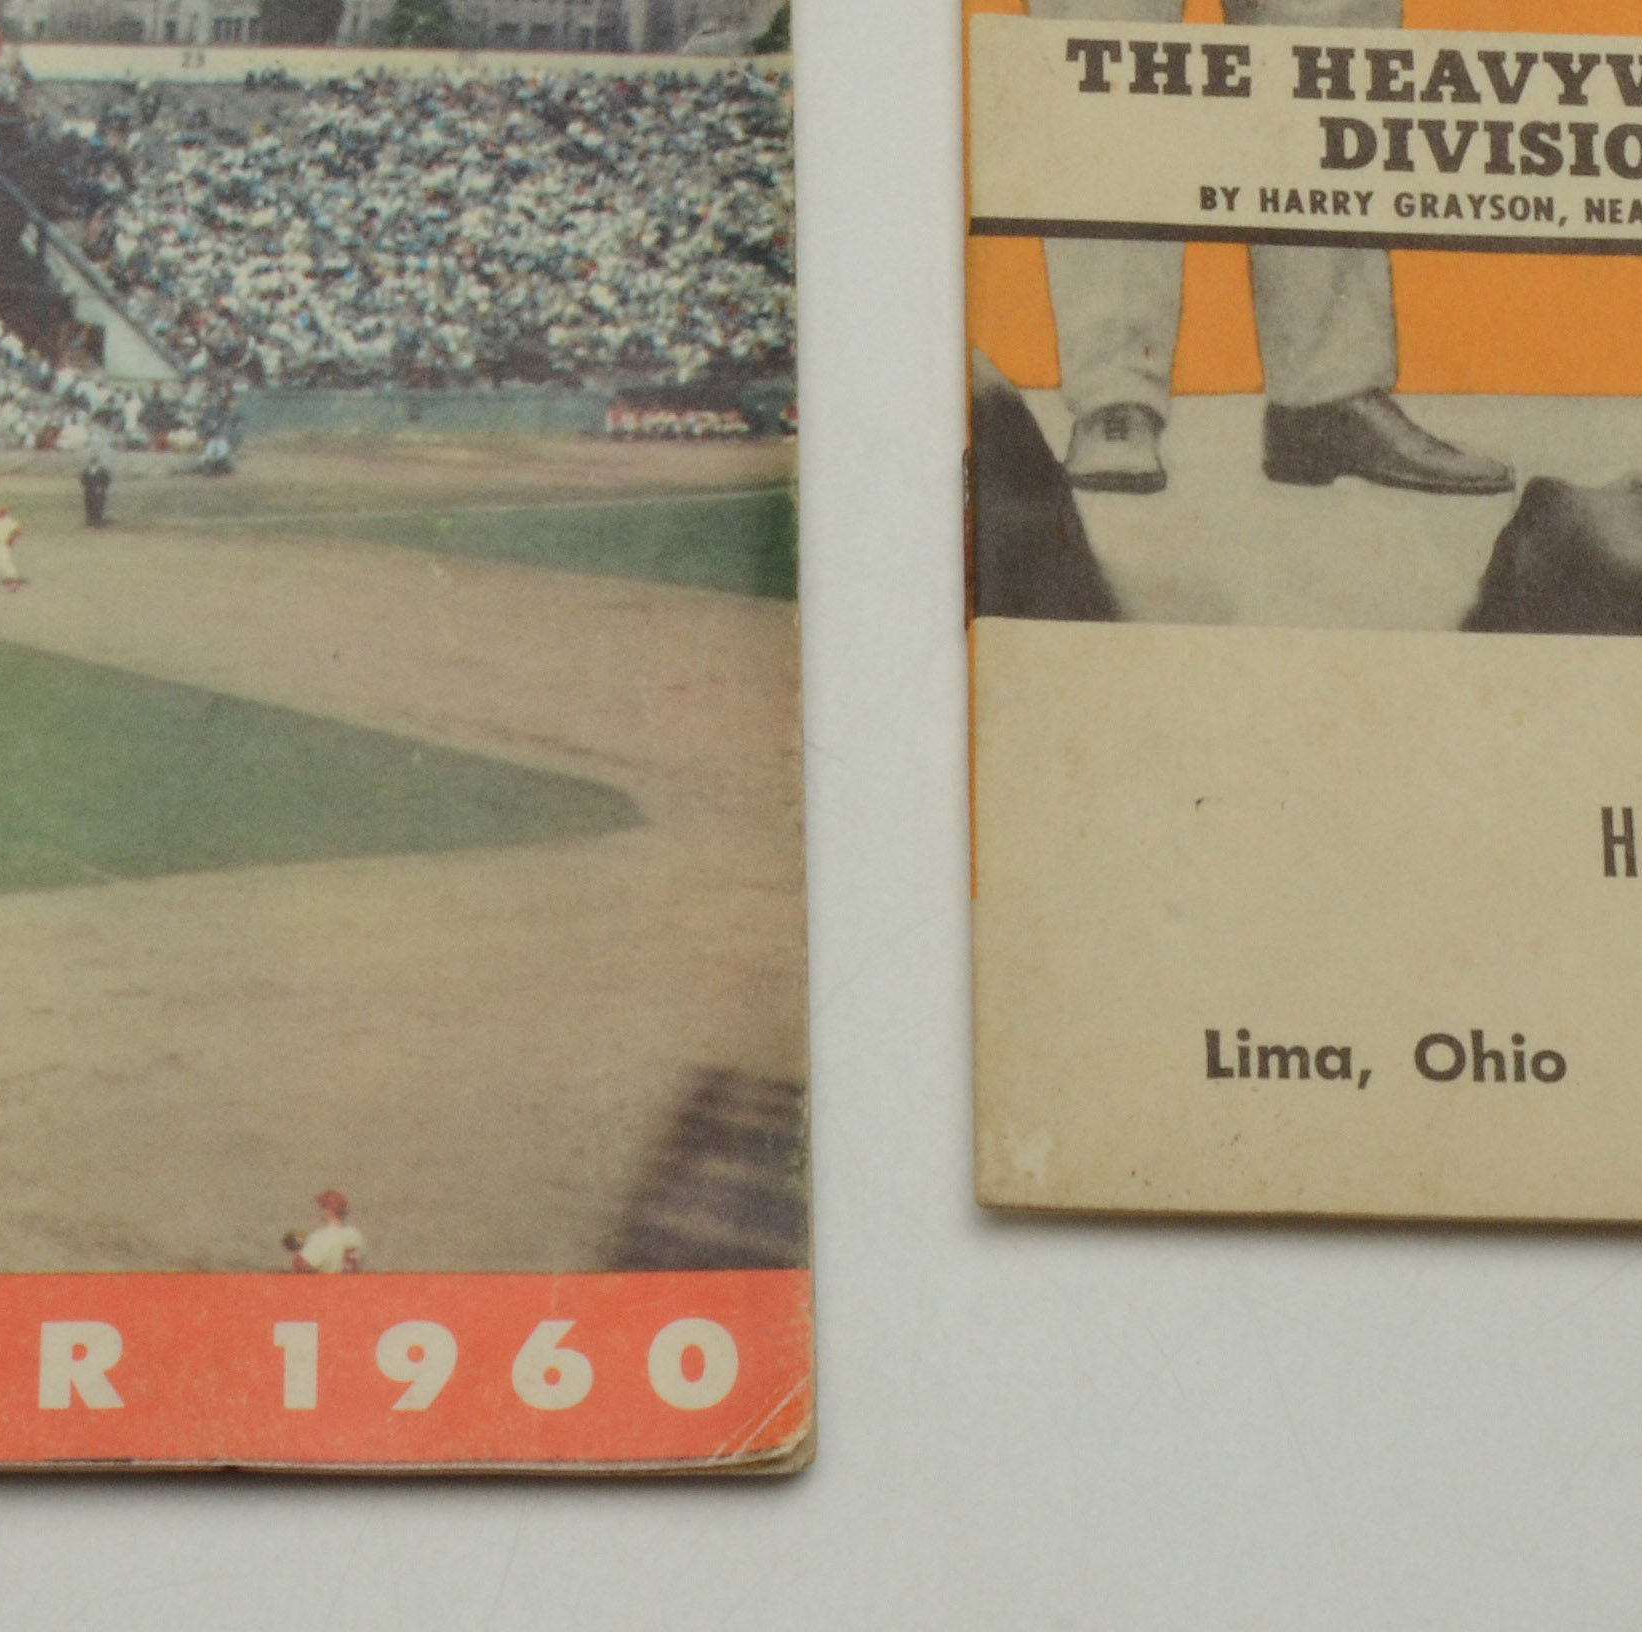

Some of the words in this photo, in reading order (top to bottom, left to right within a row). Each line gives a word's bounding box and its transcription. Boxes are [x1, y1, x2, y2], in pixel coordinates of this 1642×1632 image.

[1065, 37, 1252, 99] THE
[1199, 185, 1241, 212] BY
[1259, 187, 1374, 217] HARRY
[1393, 191, 1568, 228] GRAYSON,
[1204, 1027, 1372, 1090] Lima,
[1413, 1028, 1567, 1084] Ohio
[273, 1316, 740, 1411] 1960
